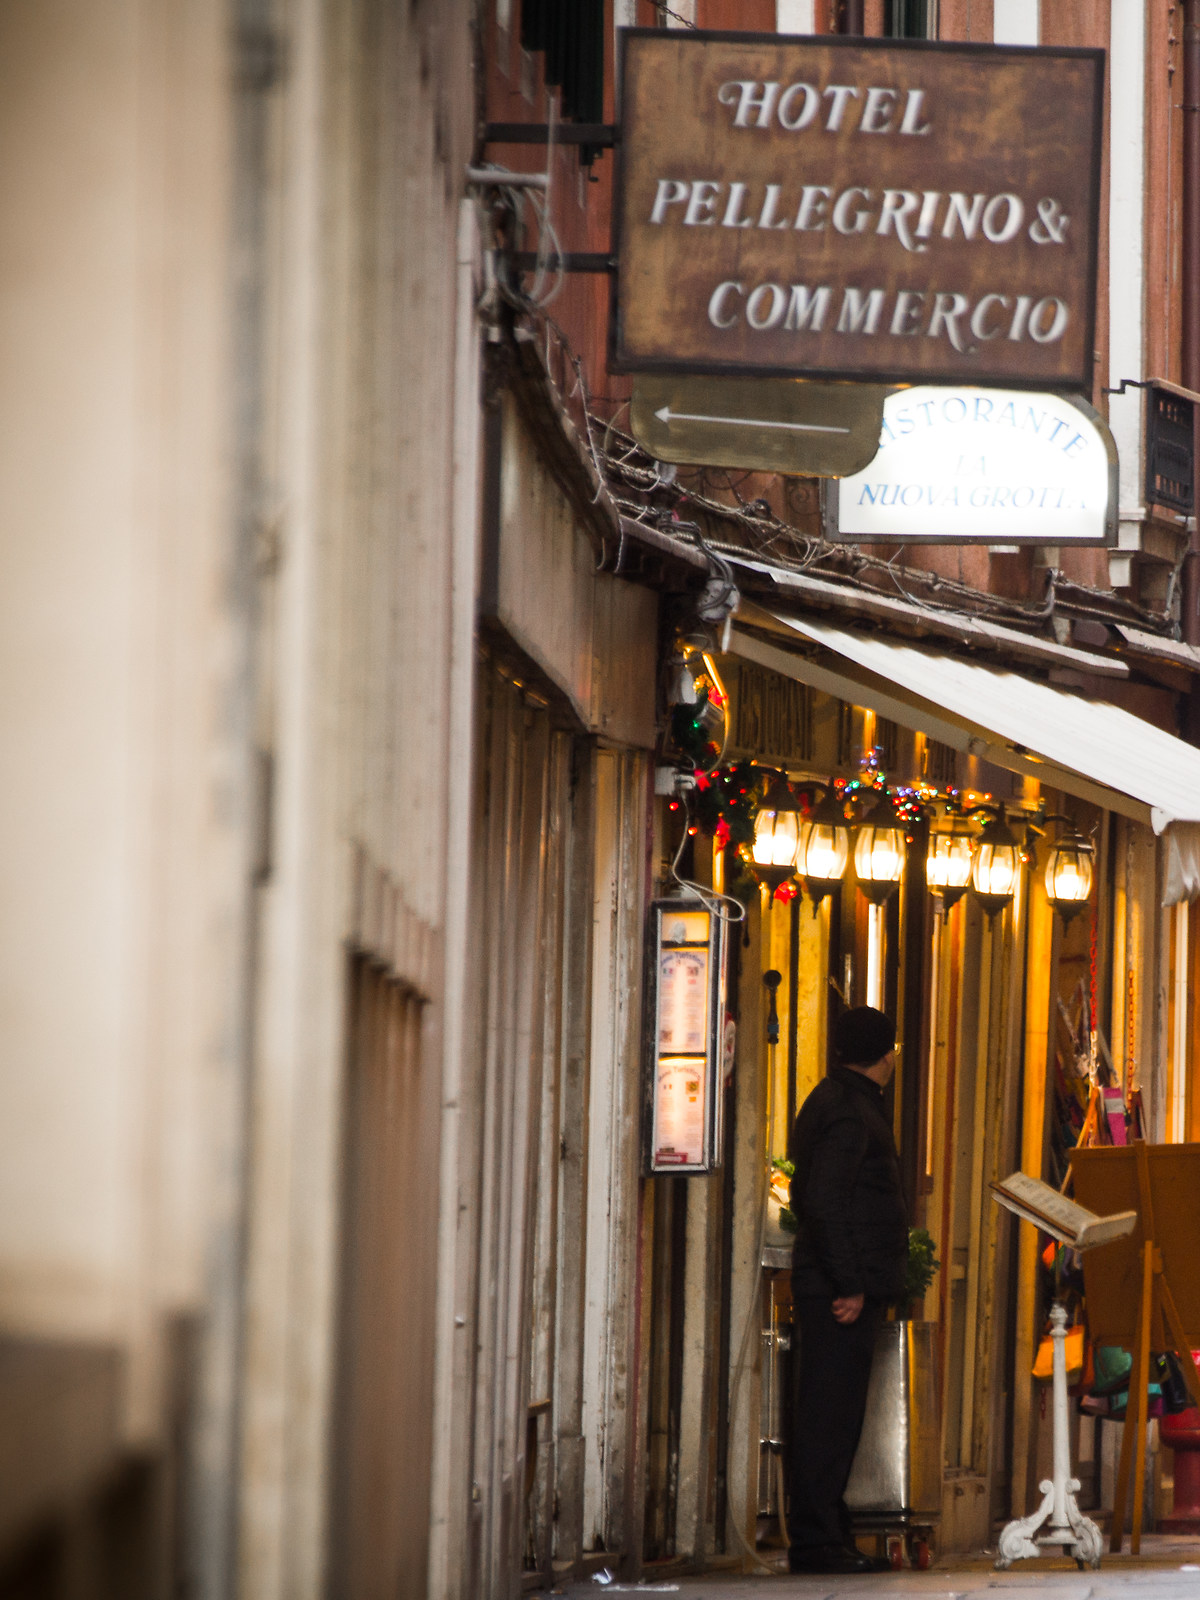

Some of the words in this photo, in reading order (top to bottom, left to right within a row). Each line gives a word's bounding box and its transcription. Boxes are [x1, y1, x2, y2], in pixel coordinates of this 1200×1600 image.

[717, 80, 931, 136] HOTEL
[649, 178, 1025, 253] PELLEGRINO
[1028, 198, 1068, 244] &
[707, 280, 1070, 355] COMMERCIO
[953, 454, 988, 477] LA
[857, 483, 961, 507] NUOVA
